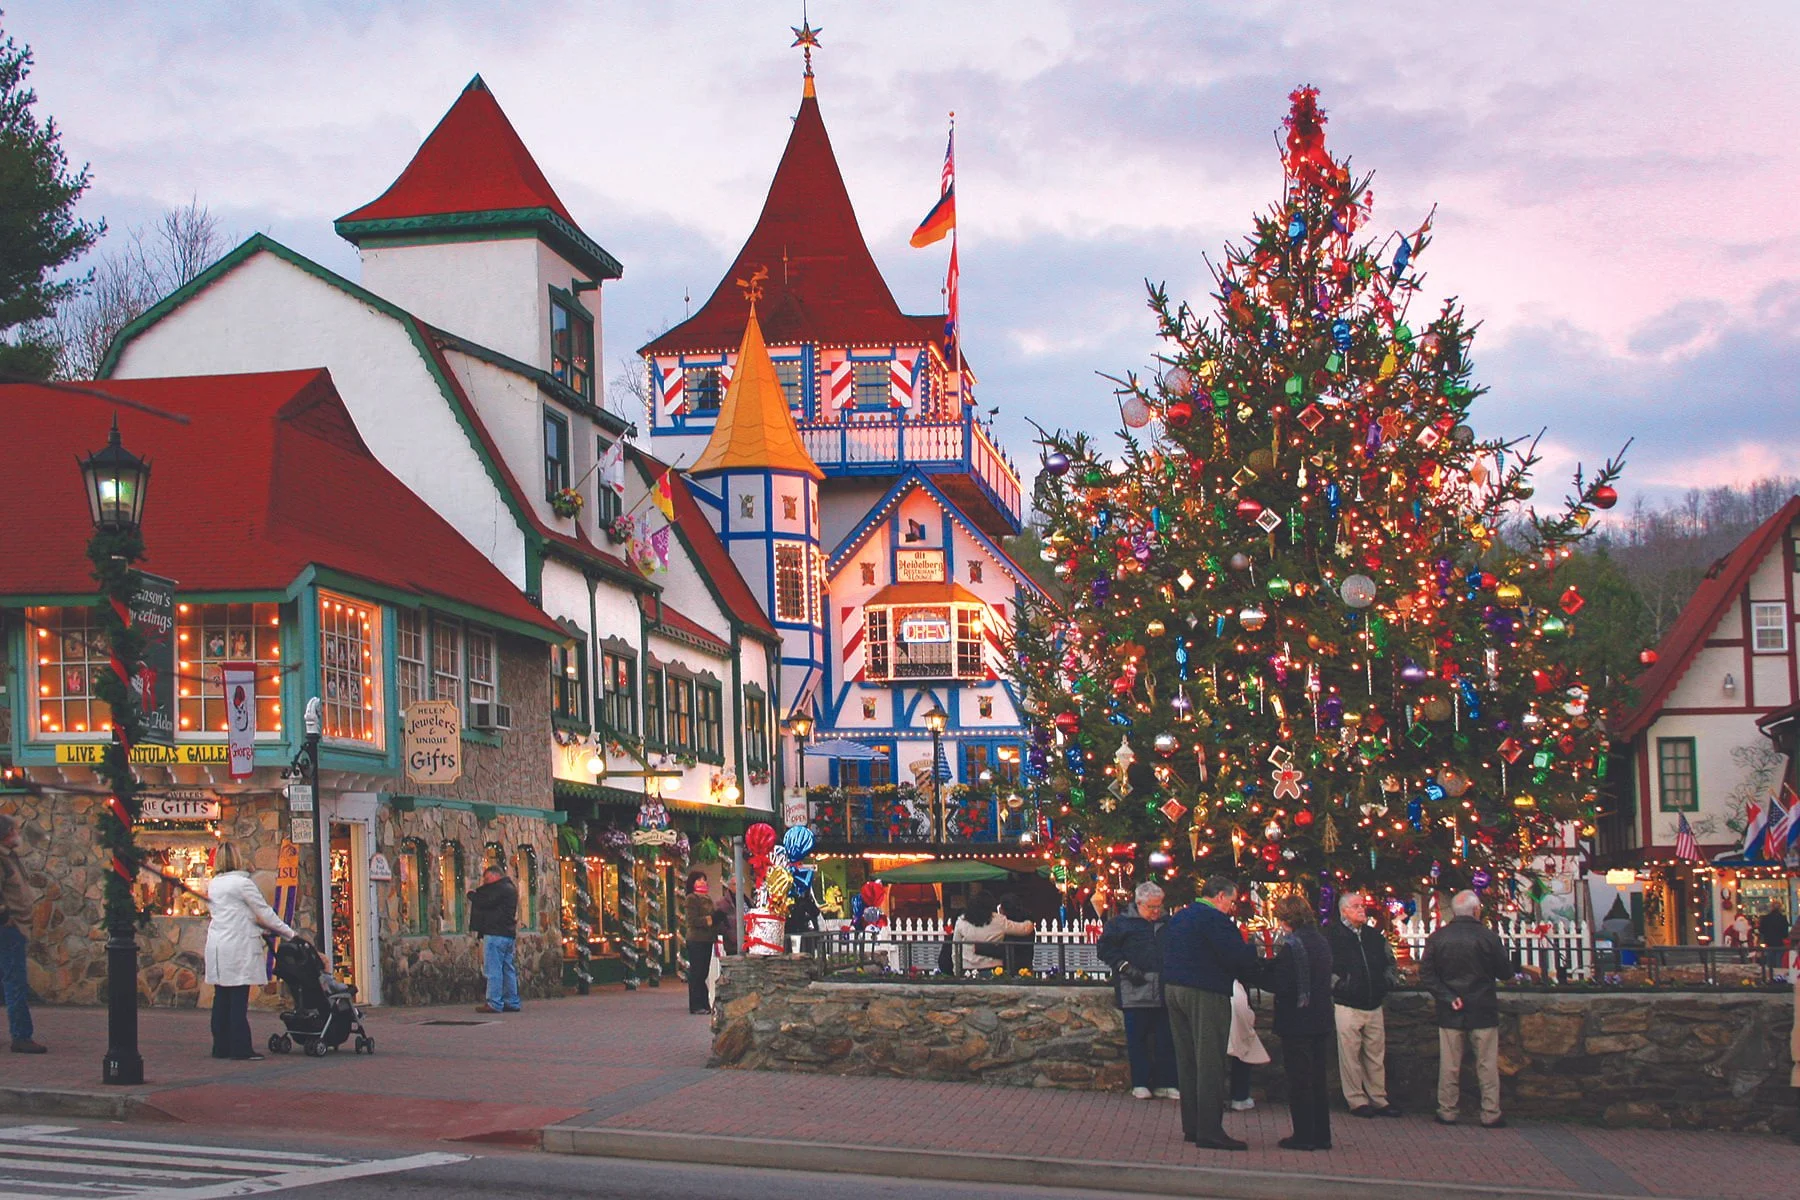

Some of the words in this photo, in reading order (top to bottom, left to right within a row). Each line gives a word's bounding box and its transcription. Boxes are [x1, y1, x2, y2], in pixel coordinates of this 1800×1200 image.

[899, 560, 944, 572] Heidelberg
[905, 624, 948, 640] OPEN
[408, 715, 456, 735] Jewelers
[416, 737, 447, 746] UNIQUE
[67, 746, 96, 762] LIVE
[411, 748, 455, 775] Gifts
